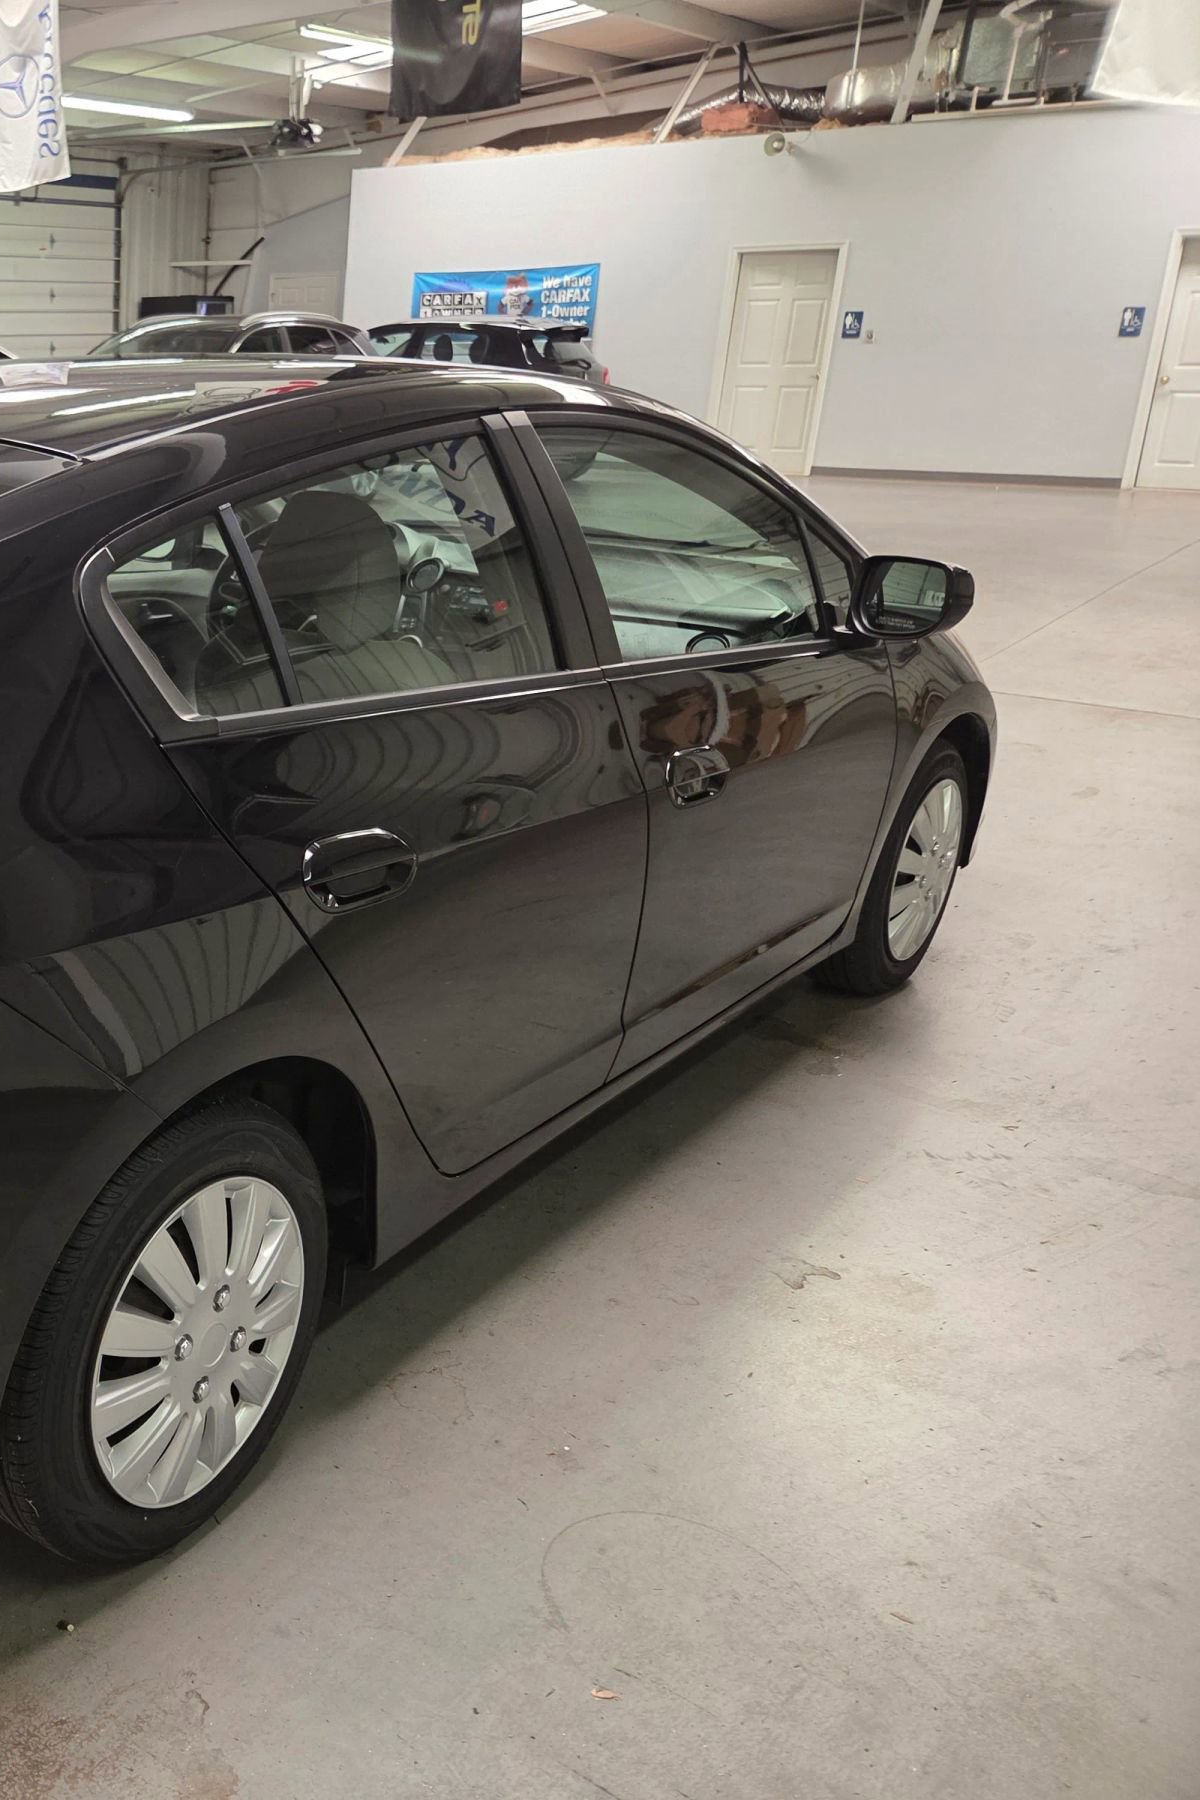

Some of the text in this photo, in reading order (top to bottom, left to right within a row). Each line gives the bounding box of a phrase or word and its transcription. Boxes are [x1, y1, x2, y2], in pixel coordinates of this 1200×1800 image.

[422, 293, 485, 307] CARFAX
[541, 287, 591, 304] CARFAX
[541, 304, 589, 318] 1-Owner
